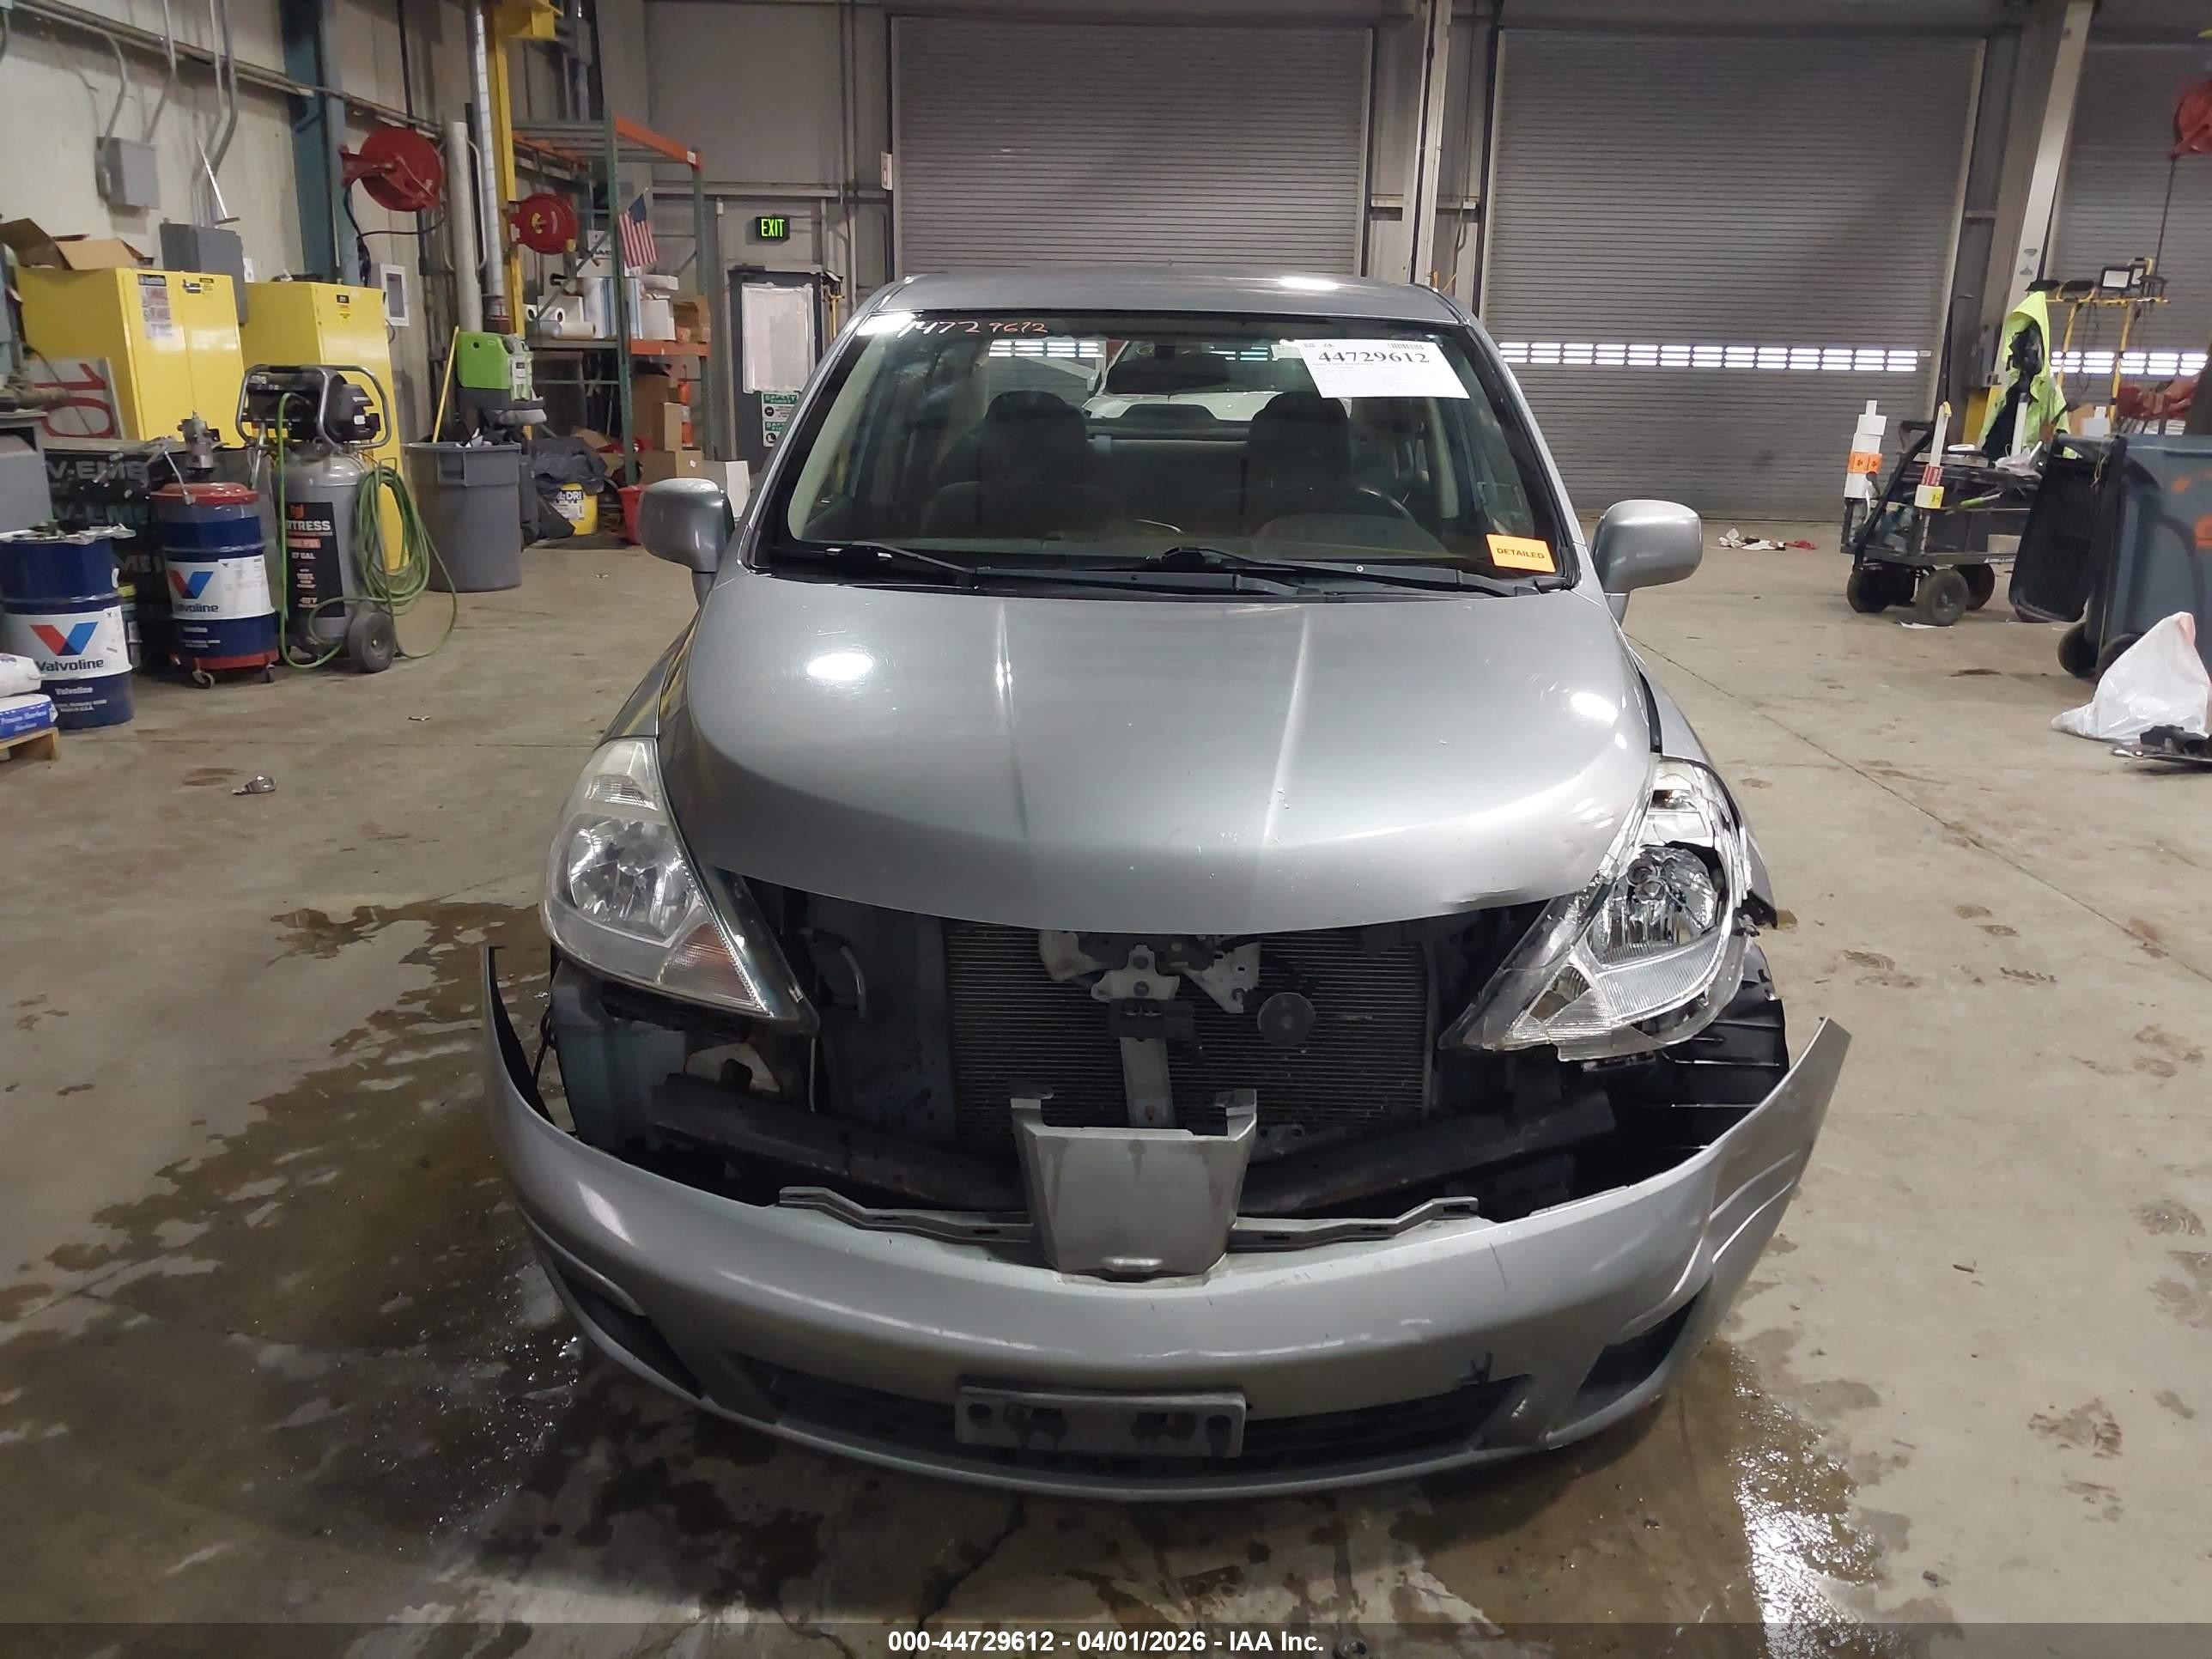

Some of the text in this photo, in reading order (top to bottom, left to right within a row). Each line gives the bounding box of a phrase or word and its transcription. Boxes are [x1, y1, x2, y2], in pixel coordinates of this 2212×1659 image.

[761, 219, 785, 237] EXIT
[1318, 351, 1430, 363] 44729612
[1497, 548, 1545, 559] DETAILED
[35, 659, 105, 672] Valvoline
